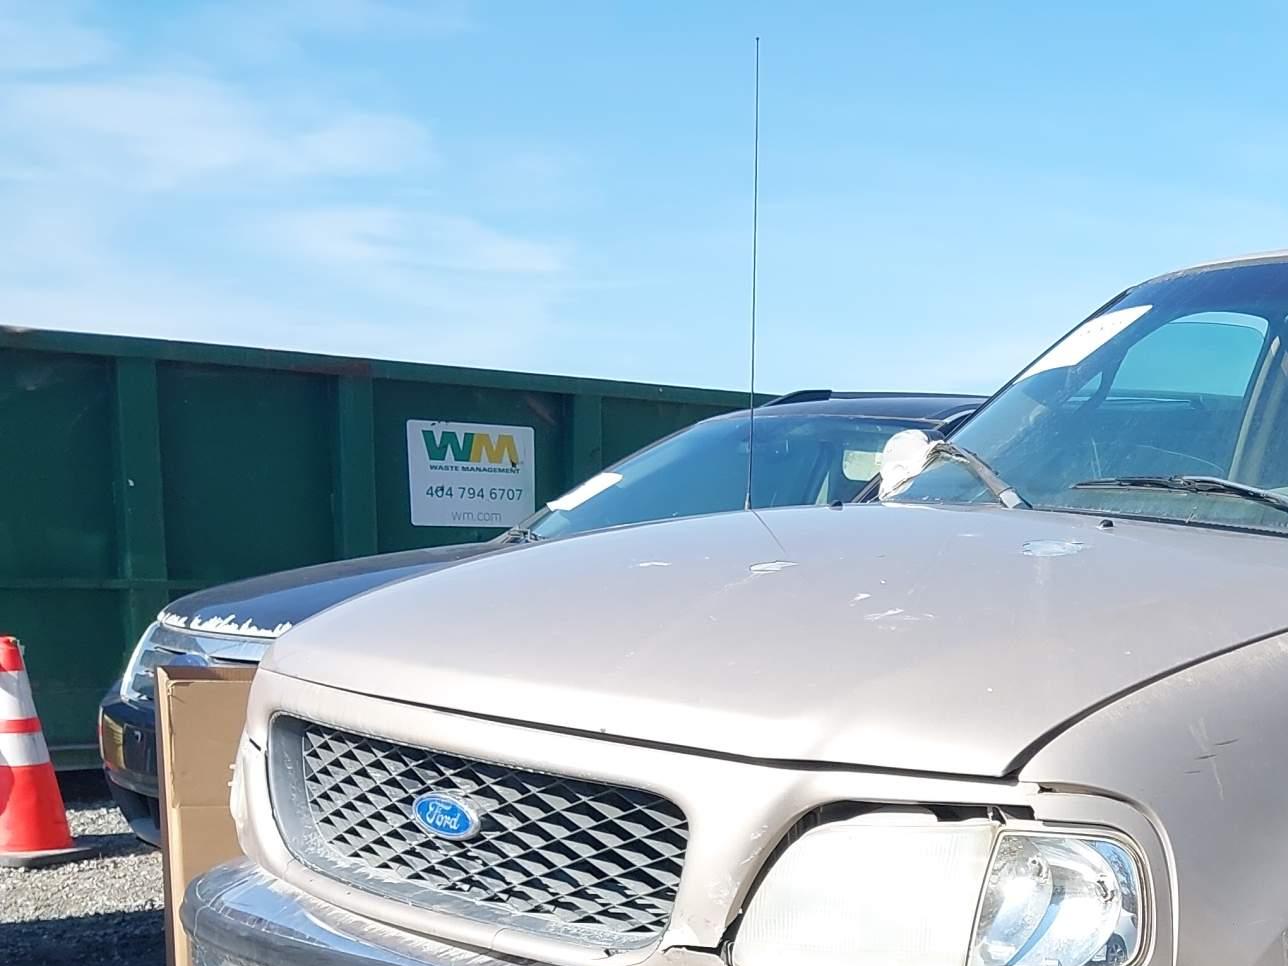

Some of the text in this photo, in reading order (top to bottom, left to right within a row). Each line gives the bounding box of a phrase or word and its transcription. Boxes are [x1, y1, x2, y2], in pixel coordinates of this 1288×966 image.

[421, 430, 519, 464] WM
[429, 464, 520, 474] WASTE MANAGEMENT
[426, 485, 523, 501] 404 794 6707
[451, 511, 502, 522] wm.com
[425, 800, 460, 830] Ford
